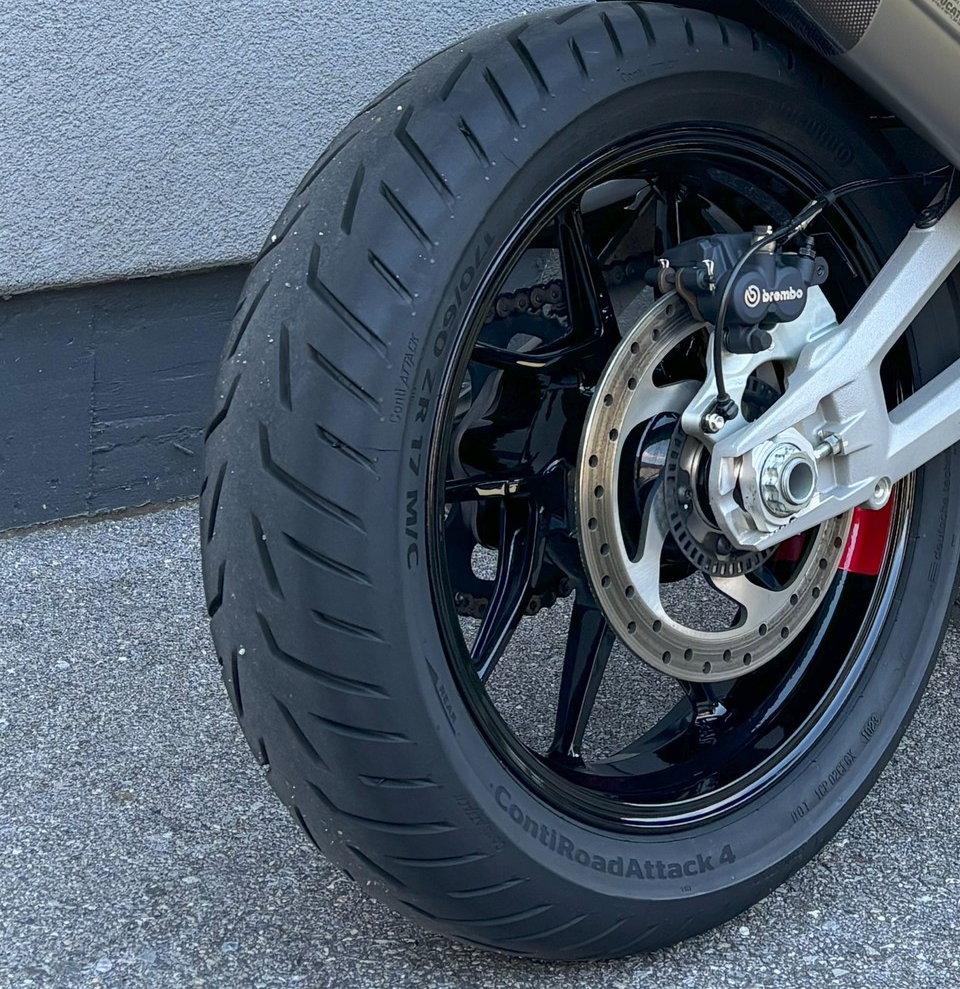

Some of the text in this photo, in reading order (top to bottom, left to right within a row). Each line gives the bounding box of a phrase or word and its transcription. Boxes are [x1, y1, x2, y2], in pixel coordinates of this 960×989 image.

[762, 286, 803, 303] brembo
[494, 784, 715, 880] ContiRoadAttack
[718, 843, 736, 866] 4
